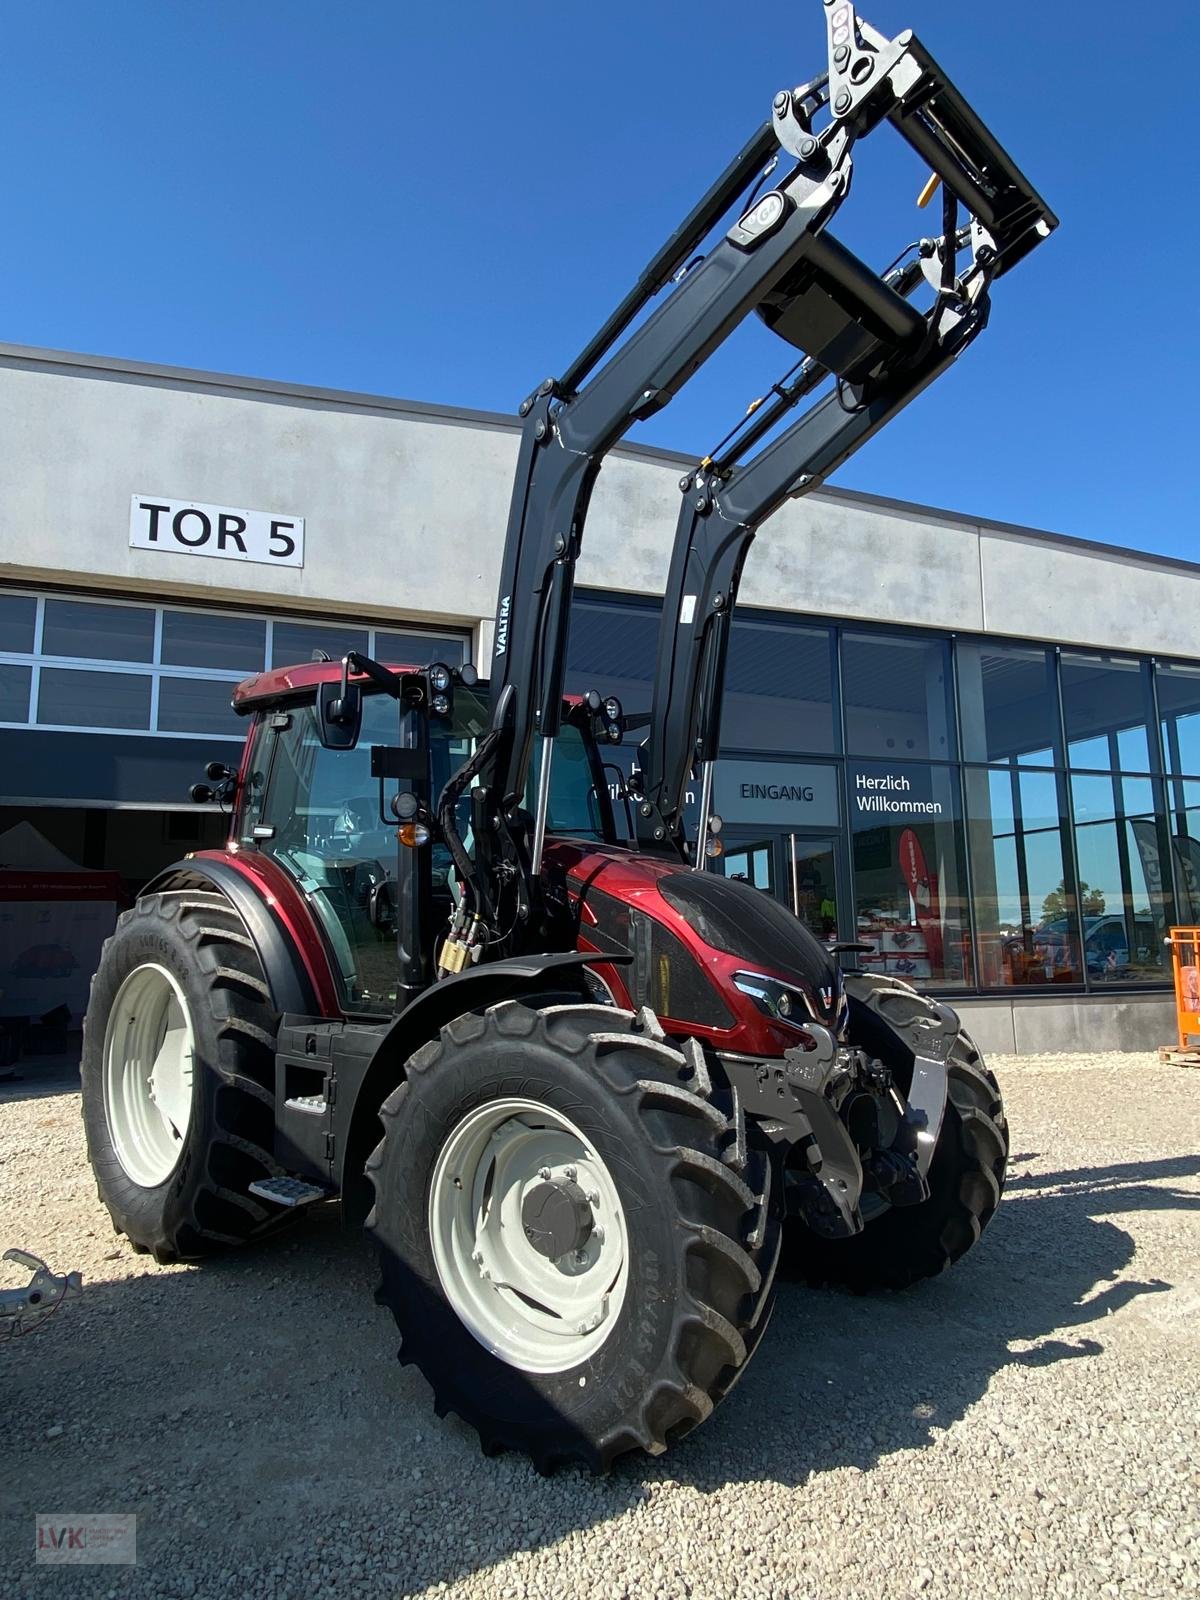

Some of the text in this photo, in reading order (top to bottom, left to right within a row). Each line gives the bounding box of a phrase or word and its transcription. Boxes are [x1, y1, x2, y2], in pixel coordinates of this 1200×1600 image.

[139, 502, 296, 558] TOR 5
[495, 595, 511, 657] VALTRA
[855, 774, 910, 791] Herzlich
[740, 783, 814, 801] EINGANG
[856, 796, 942, 814] Willkommen
